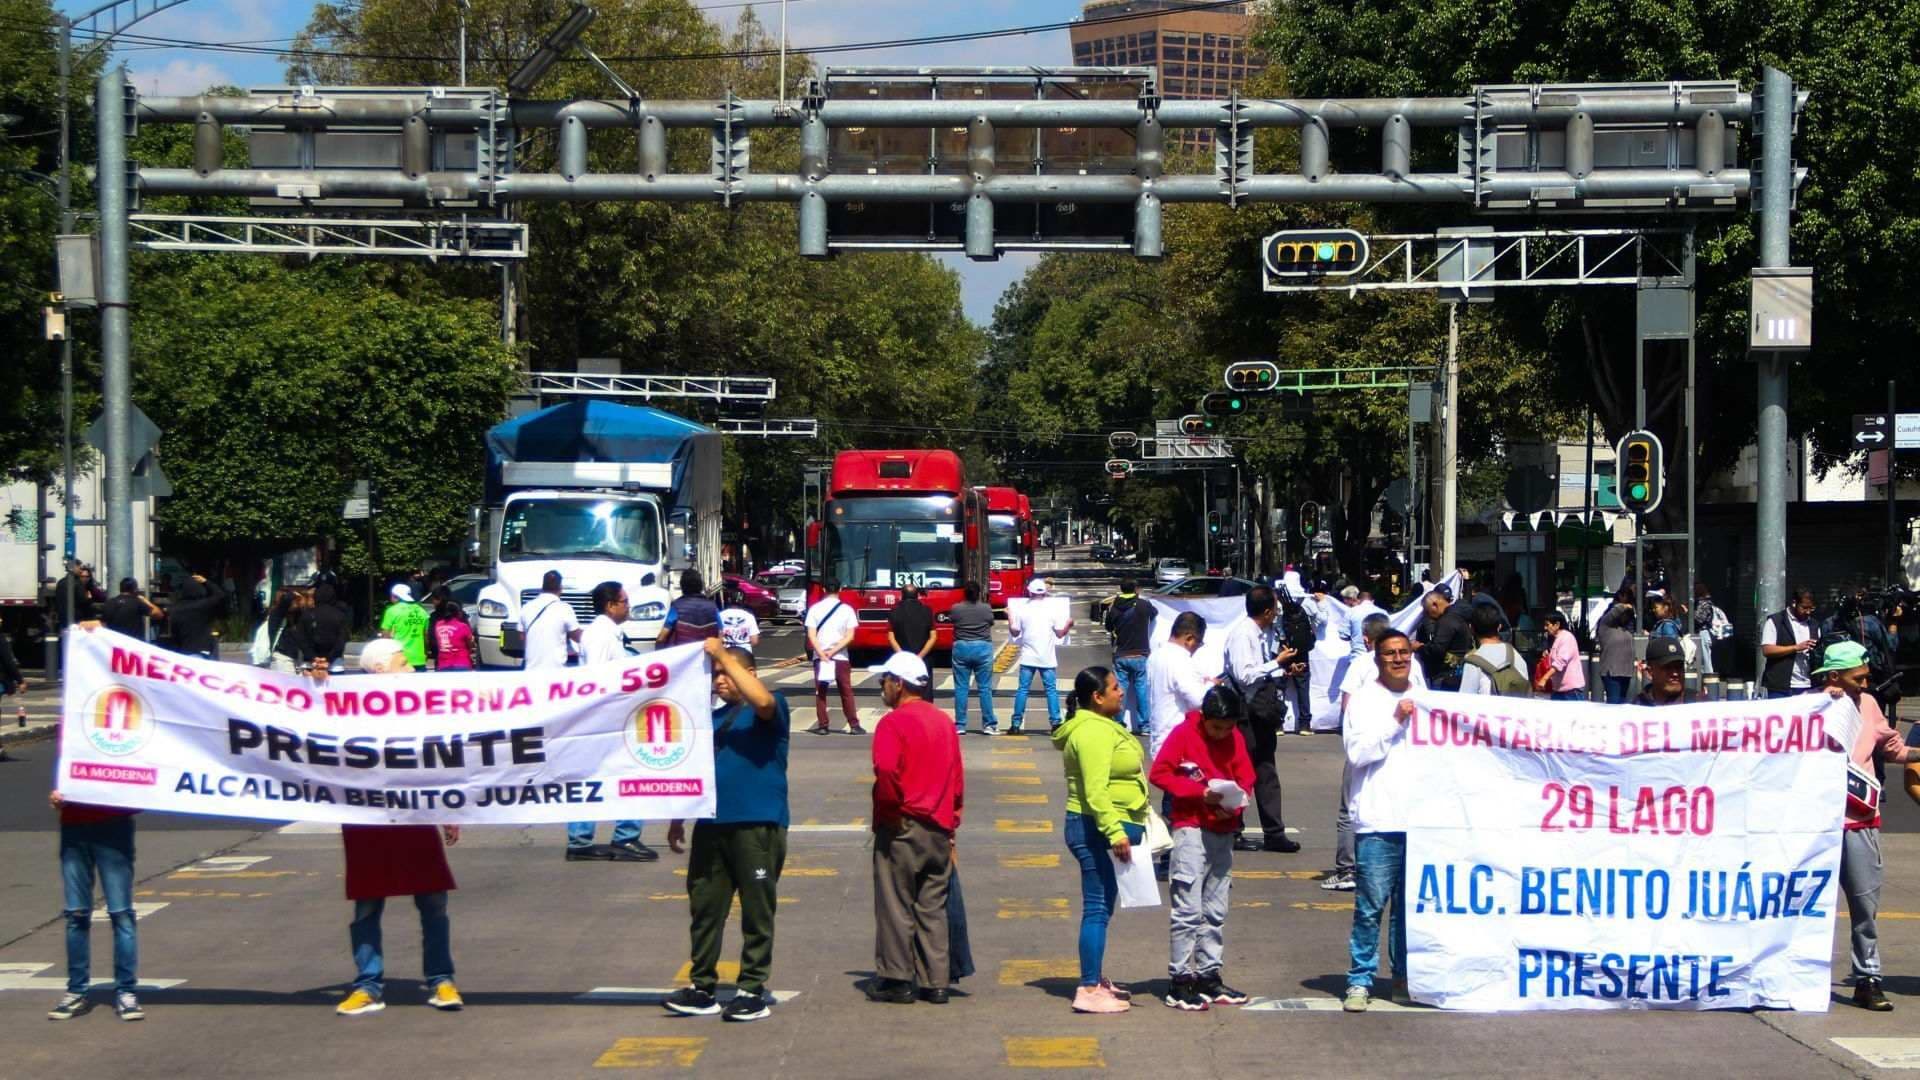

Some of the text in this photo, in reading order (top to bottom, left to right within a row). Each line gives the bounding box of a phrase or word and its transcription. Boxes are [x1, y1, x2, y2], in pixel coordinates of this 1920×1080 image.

[110, 647, 669, 717] MERCADO MODERNA No. 59
[228, 718, 547, 770] PRESENTE
[1620, 720, 1681, 756] DEL
[73, 765, 154, 783] LA MODERNA
[174, 771, 605, 810] ALCALDÍA BENITO JUÁREZ
[621, 782, 701, 794] LA MODERNA
[1541, 782, 1715, 836] 29 LAGO
[1416, 861, 1832, 921] ALC. BENITO JUÁREZ
[1517, 947, 1733, 1001] PRESENTE
